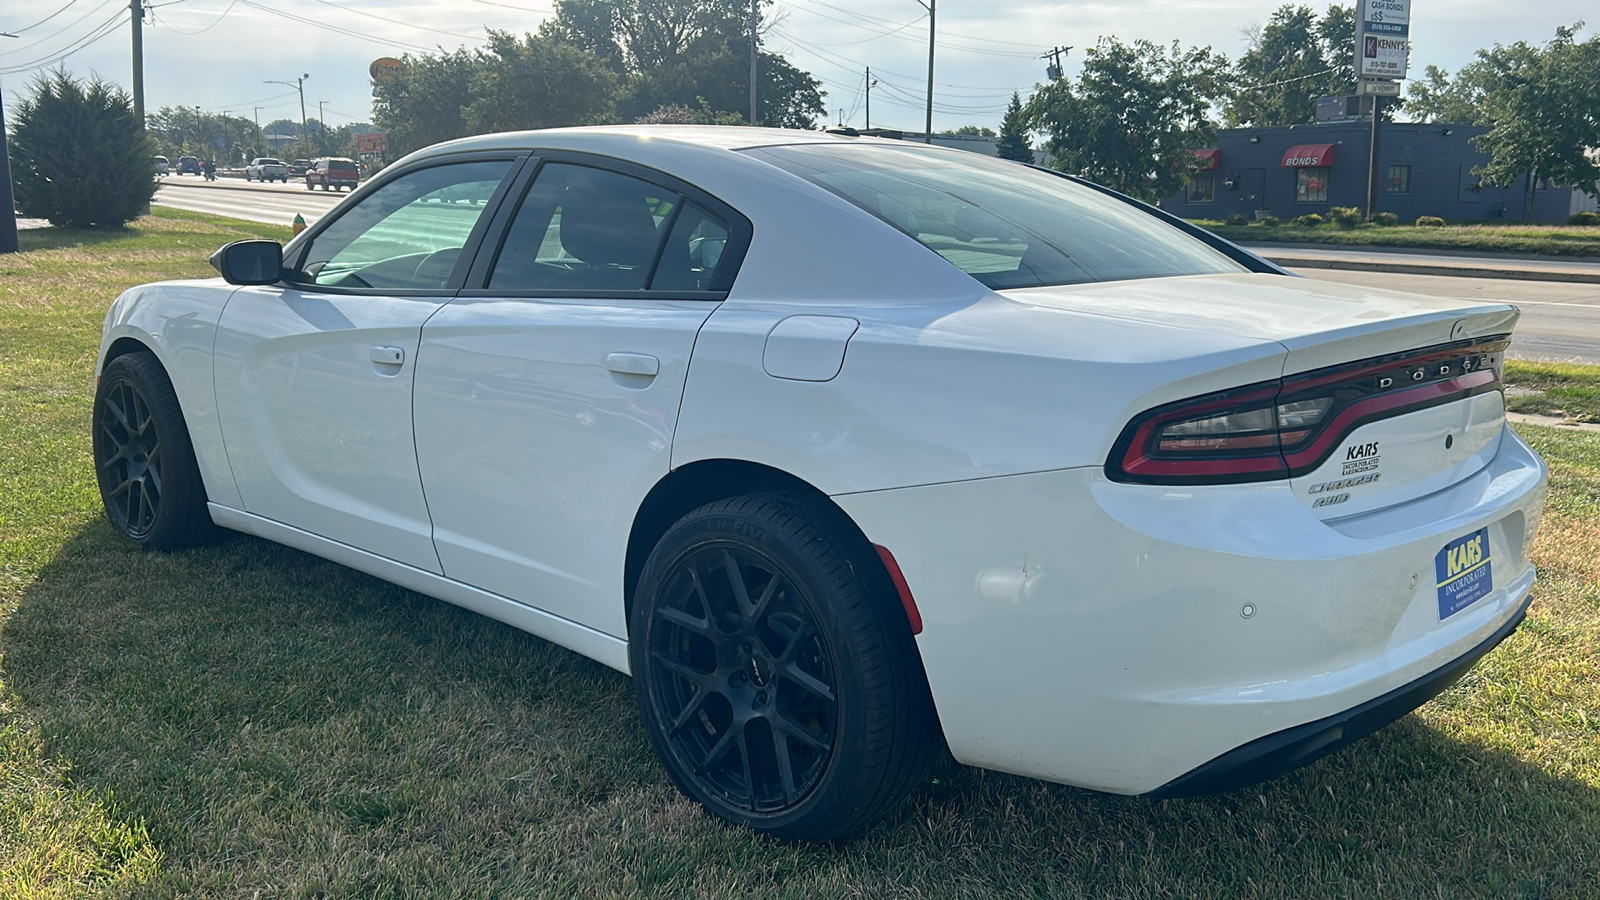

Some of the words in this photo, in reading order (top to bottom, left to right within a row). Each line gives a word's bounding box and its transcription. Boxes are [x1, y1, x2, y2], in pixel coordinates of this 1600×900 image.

[1371, 1, 1385, 9] CASH
[1386, 2, 1404, 11] BONDS
[1378, 39, 1405, 51] KENNY'S
[1285, 156, 1318, 166] BONDS
[1380, 355, 1487, 388] DODGE
[1346, 441, 1379, 460] KARS
[1342, 458, 1379, 471] INCORPORATED
[1308, 472, 1381, 494] CHARGER
[1312, 493, 1351, 508] AWD
[1447, 535, 1482, 577] KARS
[1445, 565, 1487, 596] INCORPORATED
